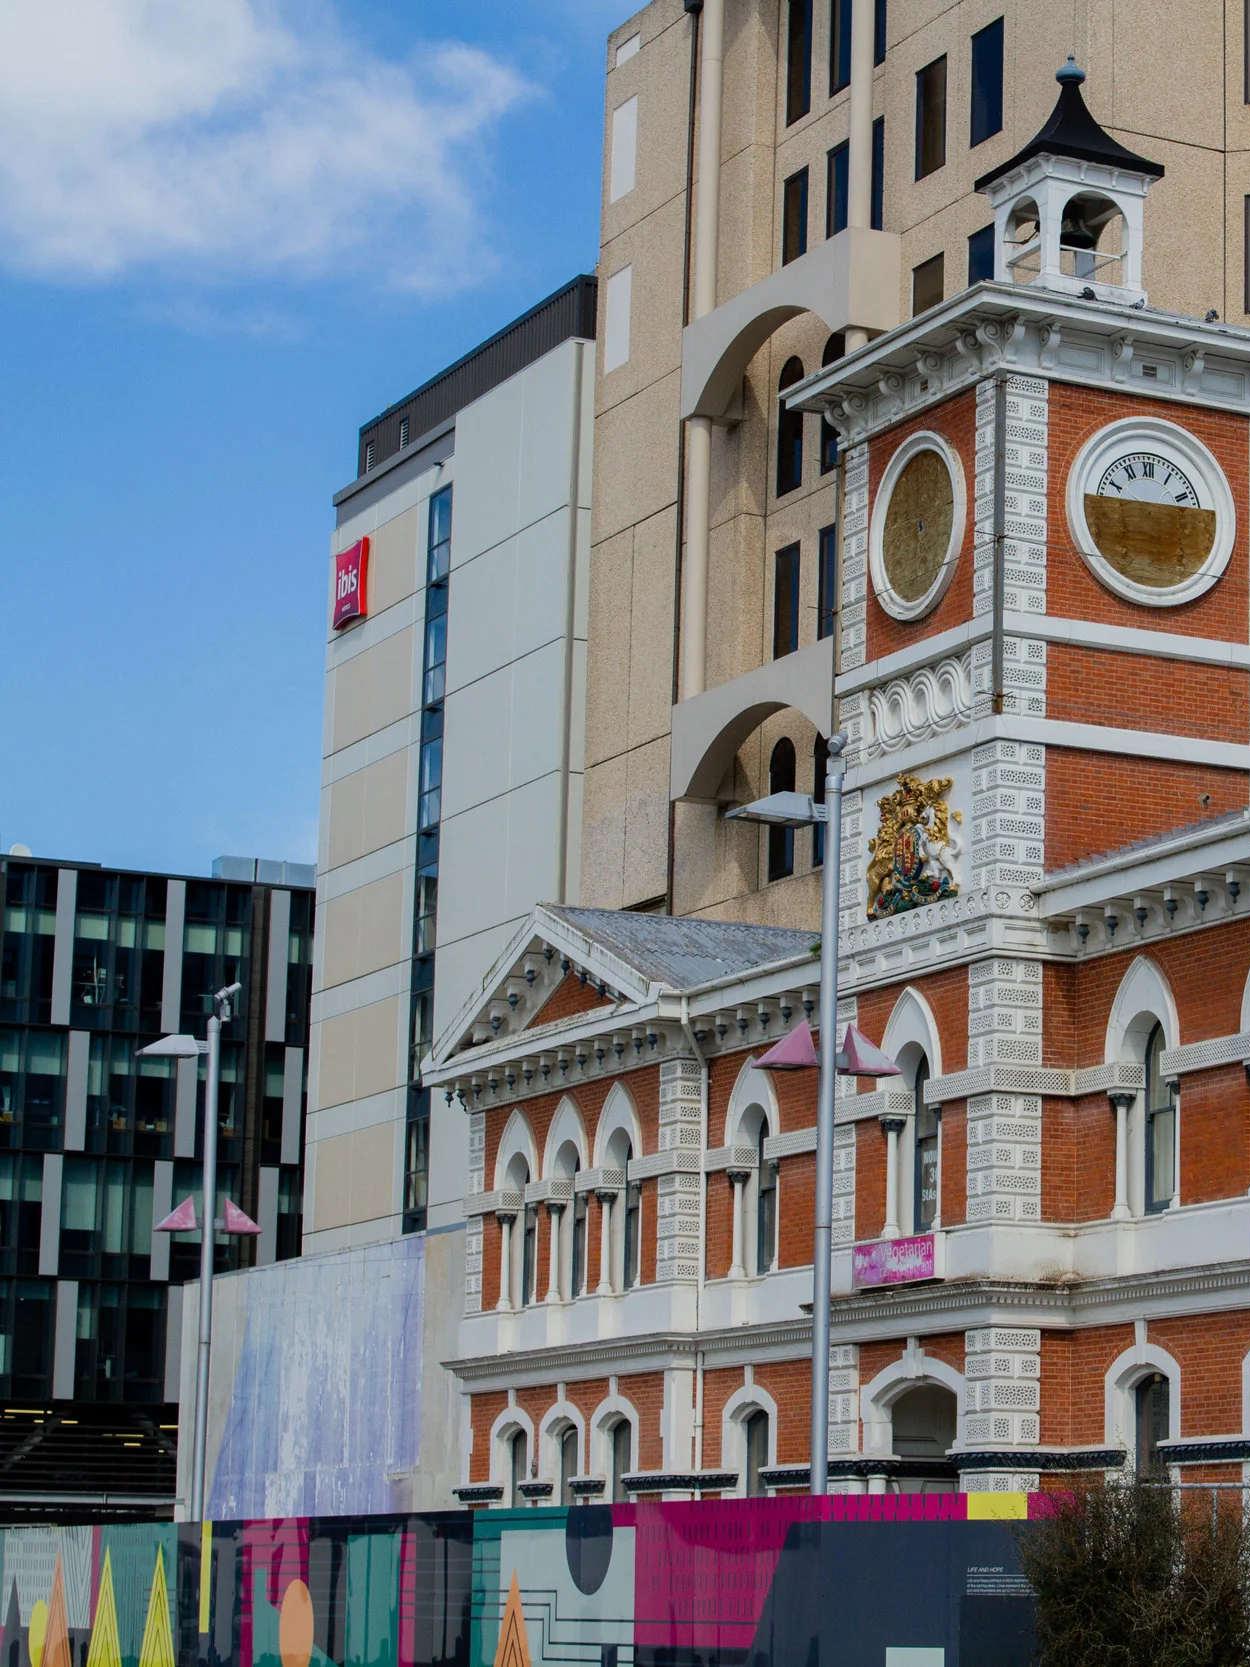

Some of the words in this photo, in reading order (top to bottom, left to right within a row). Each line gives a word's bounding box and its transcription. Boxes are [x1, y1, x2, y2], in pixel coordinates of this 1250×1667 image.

[1124, 464, 1136, 481] XI
[1142, 462, 1154, 478] XII
[337, 564, 358, 600] ibis
[881, 1239, 932, 1263] vegetarian
